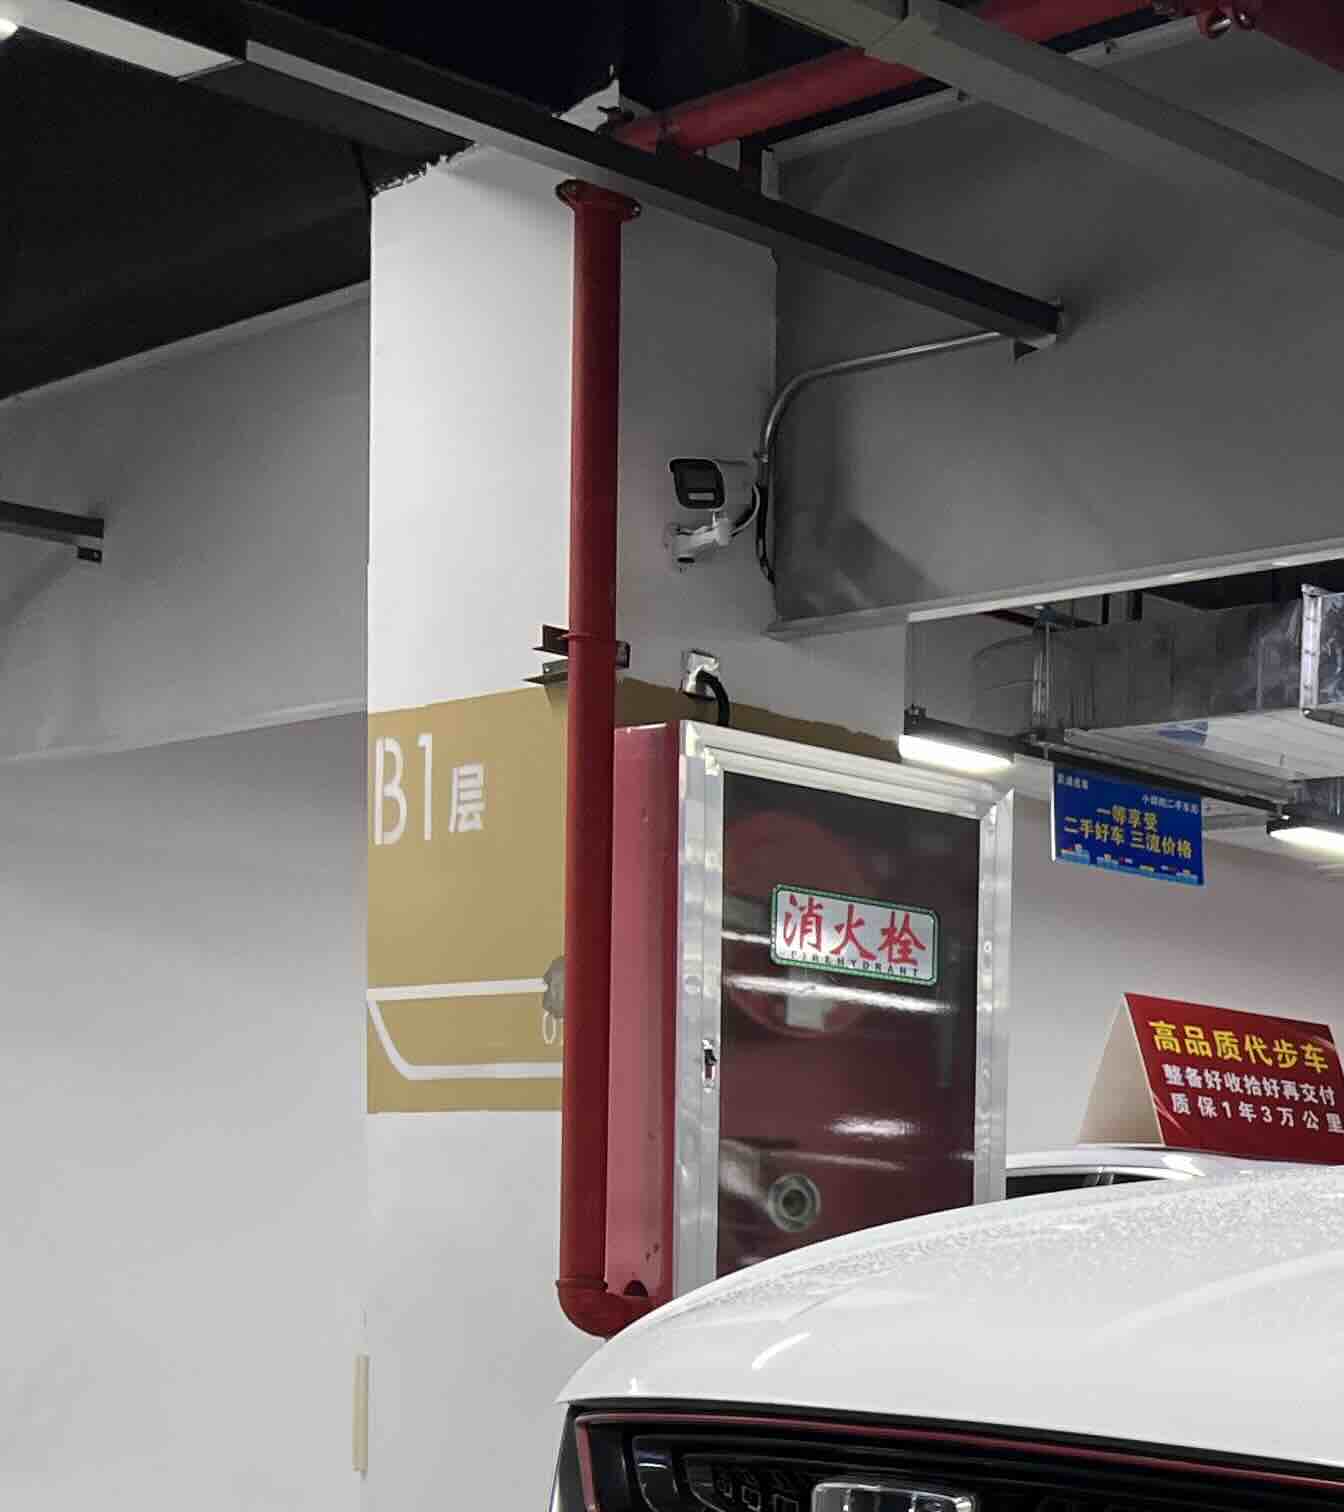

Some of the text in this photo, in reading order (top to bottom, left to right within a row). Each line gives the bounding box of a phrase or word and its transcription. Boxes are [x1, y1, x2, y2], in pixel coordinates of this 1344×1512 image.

[1064, 816, 1125, 846] 二手好车
[783, 894, 926, 966] 消火栓
[1148, 1020, 1329, 1073] 高品质代步车
[1162, 1063, 1335, 1107] 整备好收拾好再交付
